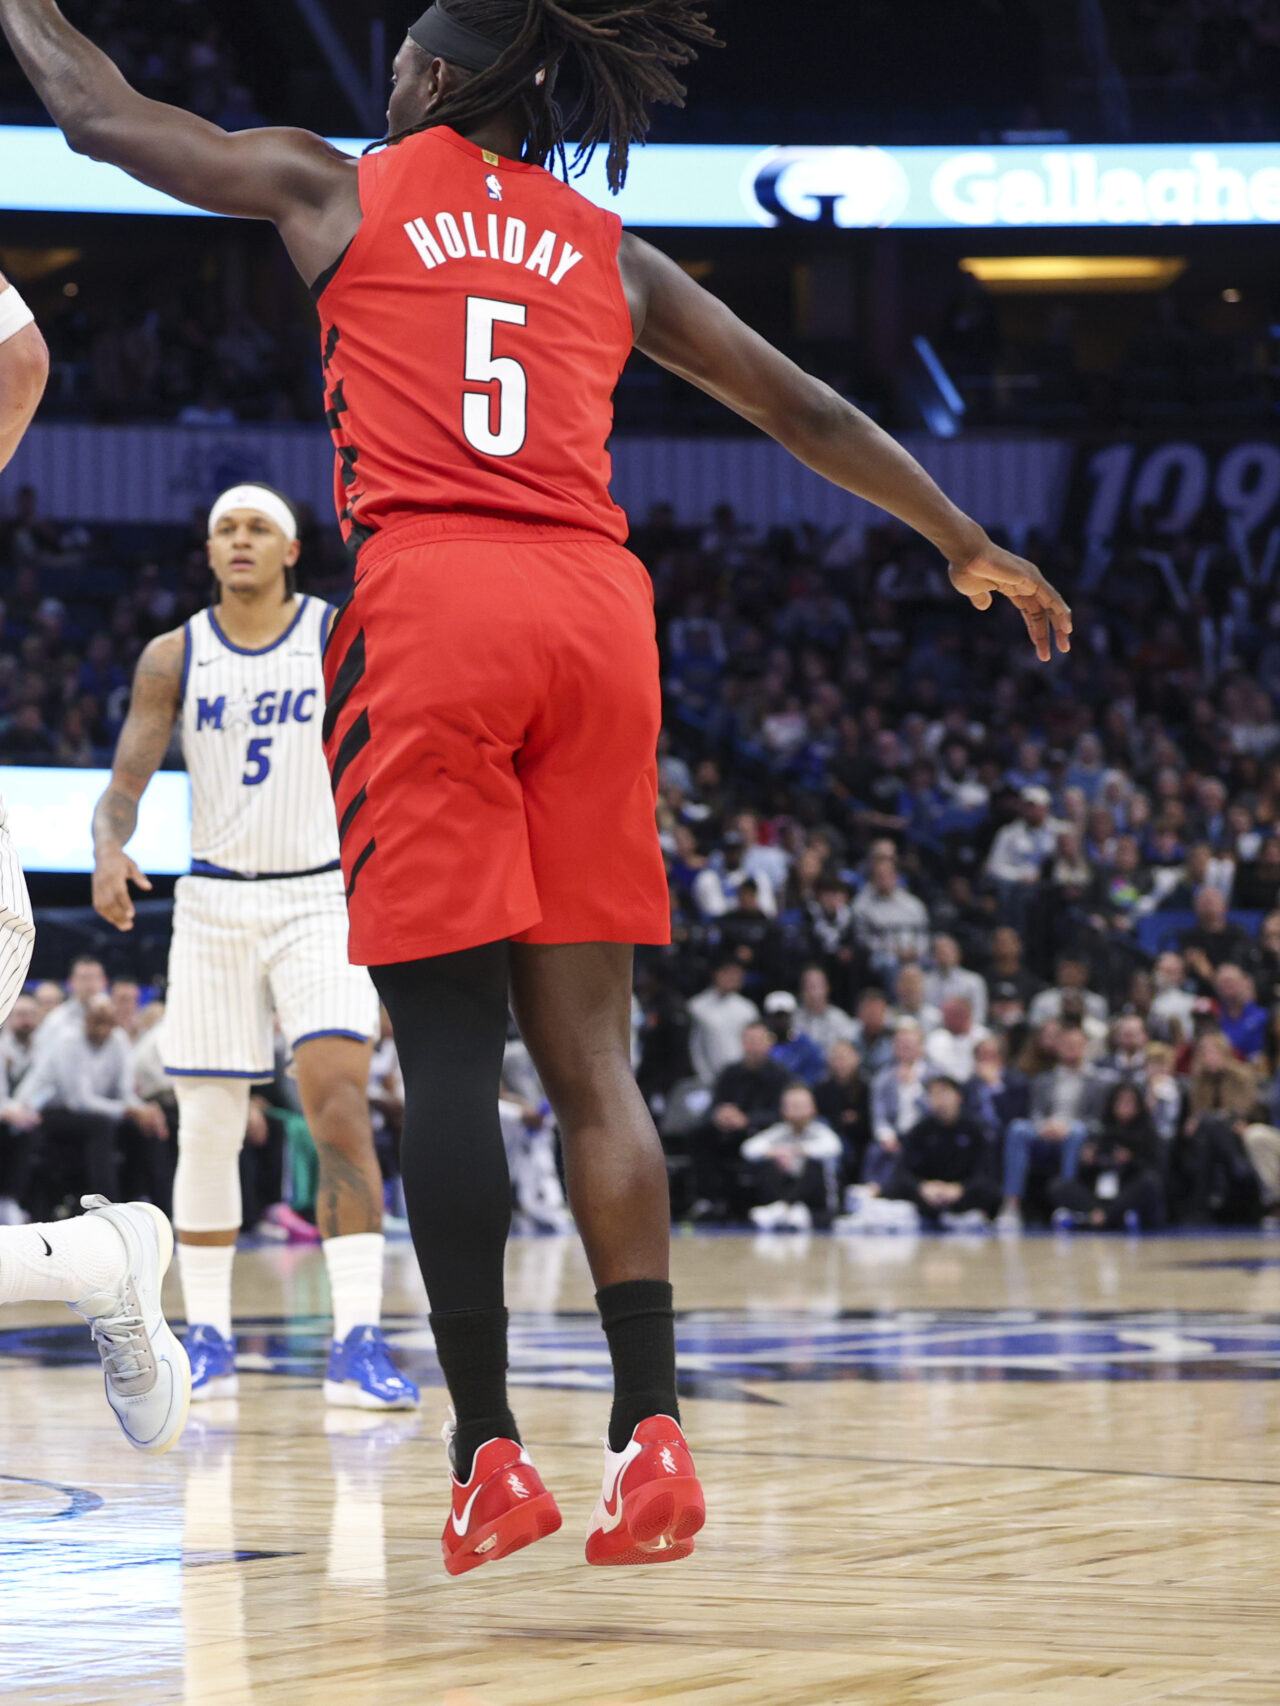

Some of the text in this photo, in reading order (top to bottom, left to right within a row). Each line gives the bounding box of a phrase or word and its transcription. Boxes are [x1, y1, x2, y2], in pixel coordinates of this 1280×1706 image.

[403, 211, 584, 286] HOLIDAY
[462, 294, 528, 459] 5
[242, 737, 273, 786] 5
